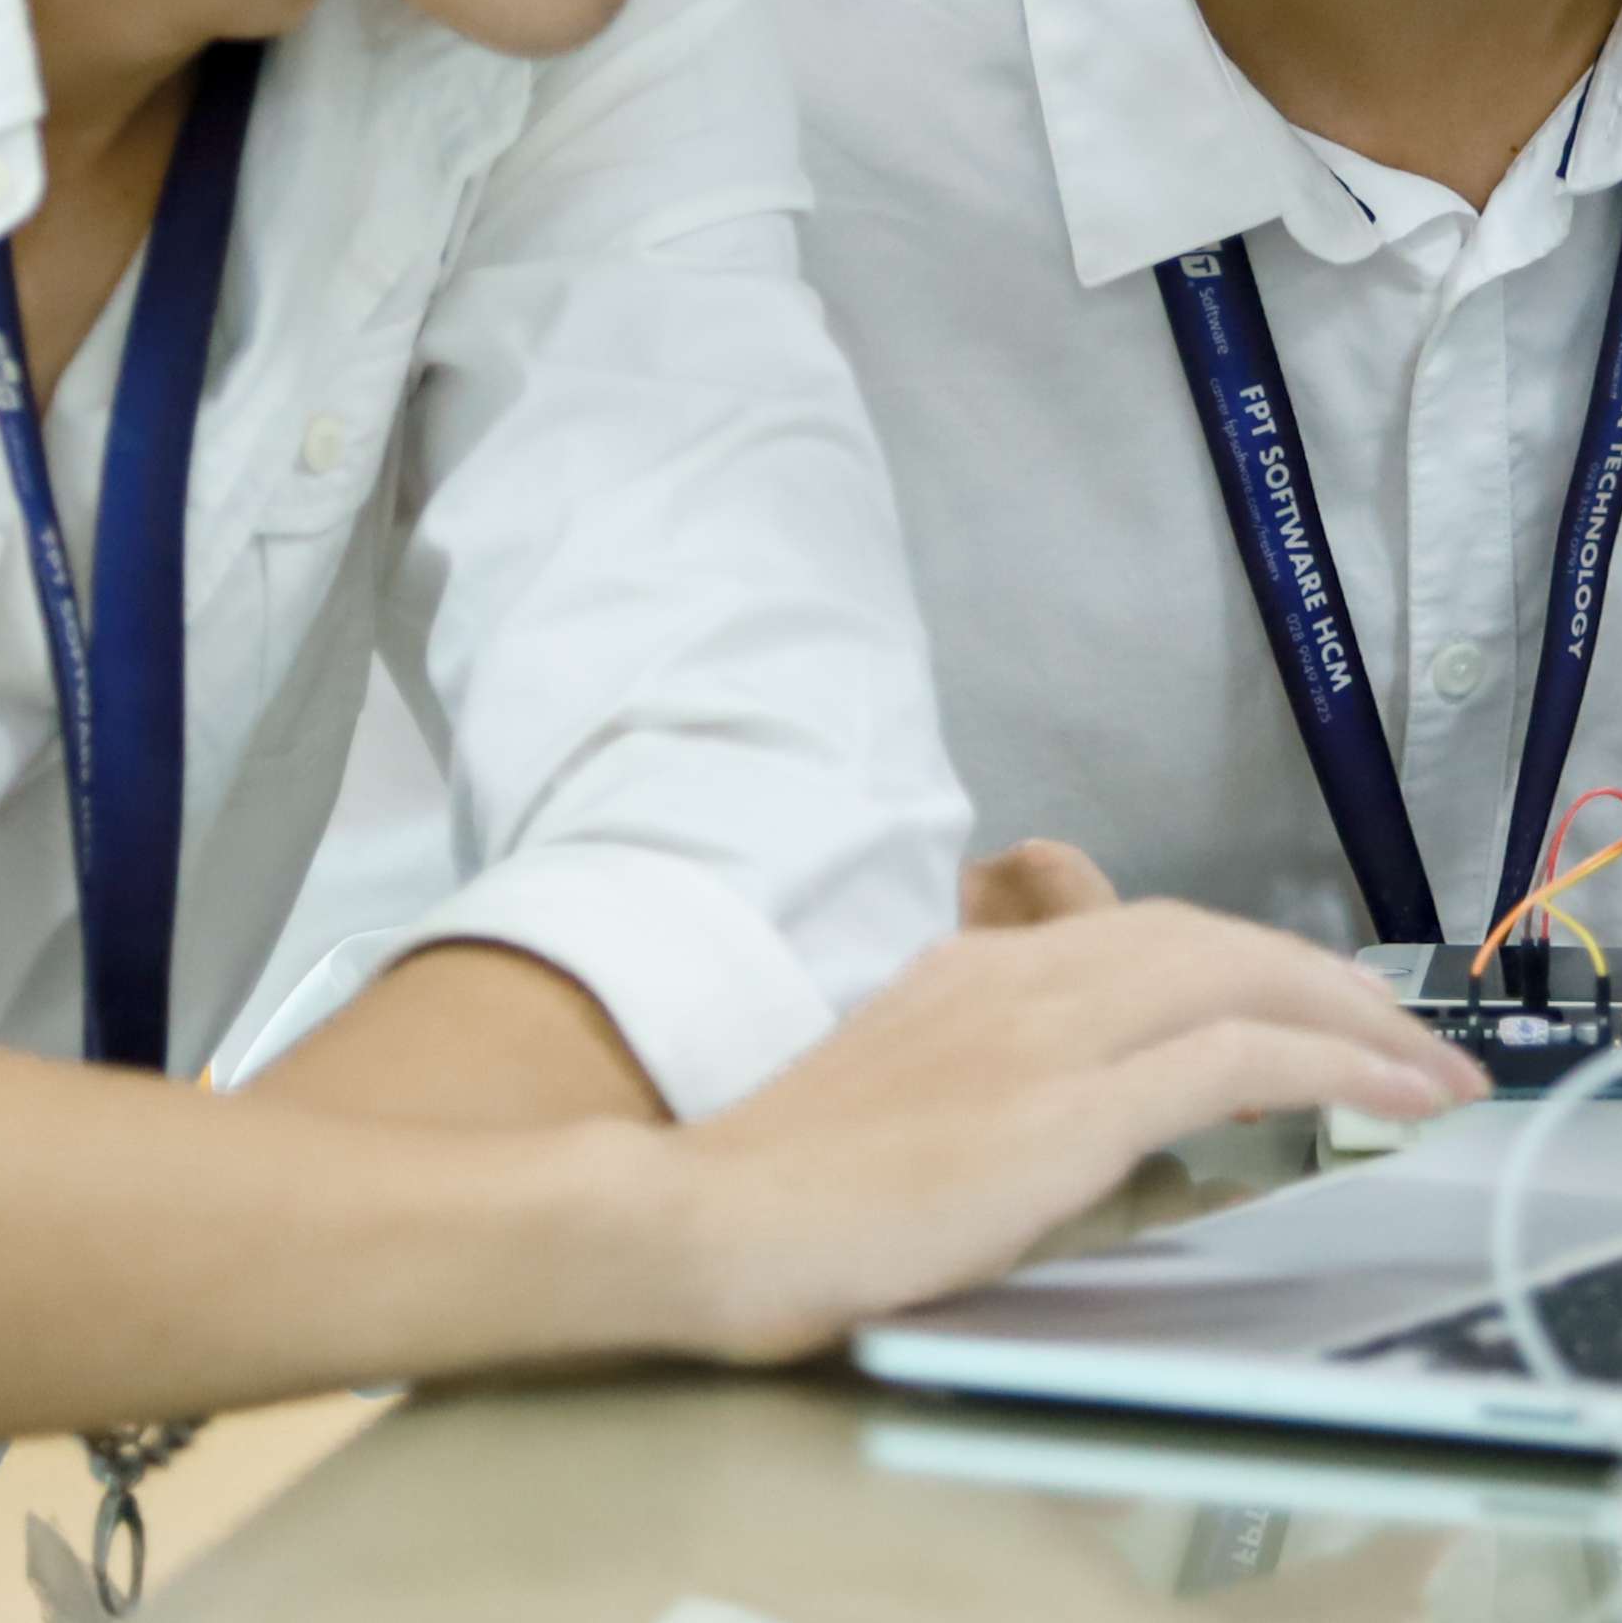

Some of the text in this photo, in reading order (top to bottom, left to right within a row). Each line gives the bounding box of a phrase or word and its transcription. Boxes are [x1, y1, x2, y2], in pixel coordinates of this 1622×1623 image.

[1198, 286, 1229, 356] Software
[1239, 383, 1353, 694] FPT SOFTWARE HCM
[1286, 612, 1305, 643] 028
